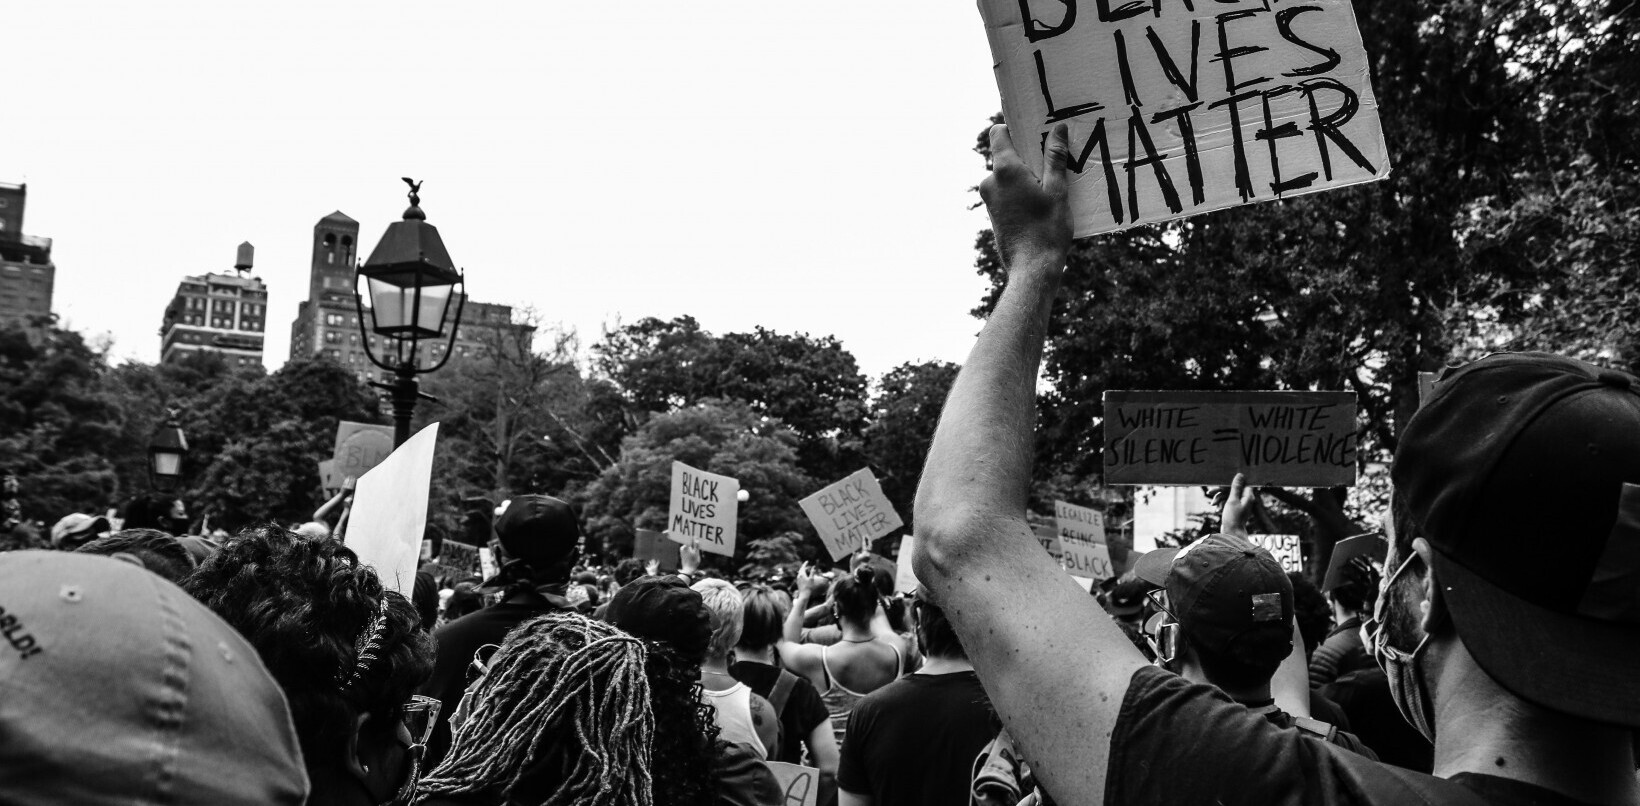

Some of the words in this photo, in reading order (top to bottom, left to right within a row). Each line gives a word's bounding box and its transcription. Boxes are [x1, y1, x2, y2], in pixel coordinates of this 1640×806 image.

[1033, 6, 1341, 124] LIVES
[1041, 78, 1377, 224] MATTER
[1118, 406, 1200, 429] WHITE
[1248, 403, 1337, 431] WHITE
[1107, 437, 1208, 467] SILENCE
[1240, 431, 1358, 468] VIOLENCE
[682, 471, 719, 502] BLACK
[818, 479, 871, 515] BLACK
[682, 497, 715, 519] LIVES
[832, 500, 876, 530] LIVES
[1057, 506, 1101, 527] LEGALIZE
[672, 514, 724, 545] MATTER
[834, 512, 893, 550] MATTER
[1062, 527, 1097, 549] BEING
[1065, 551, 1111, 577] BLACK
[0, 606, 43, 660] RLD!
